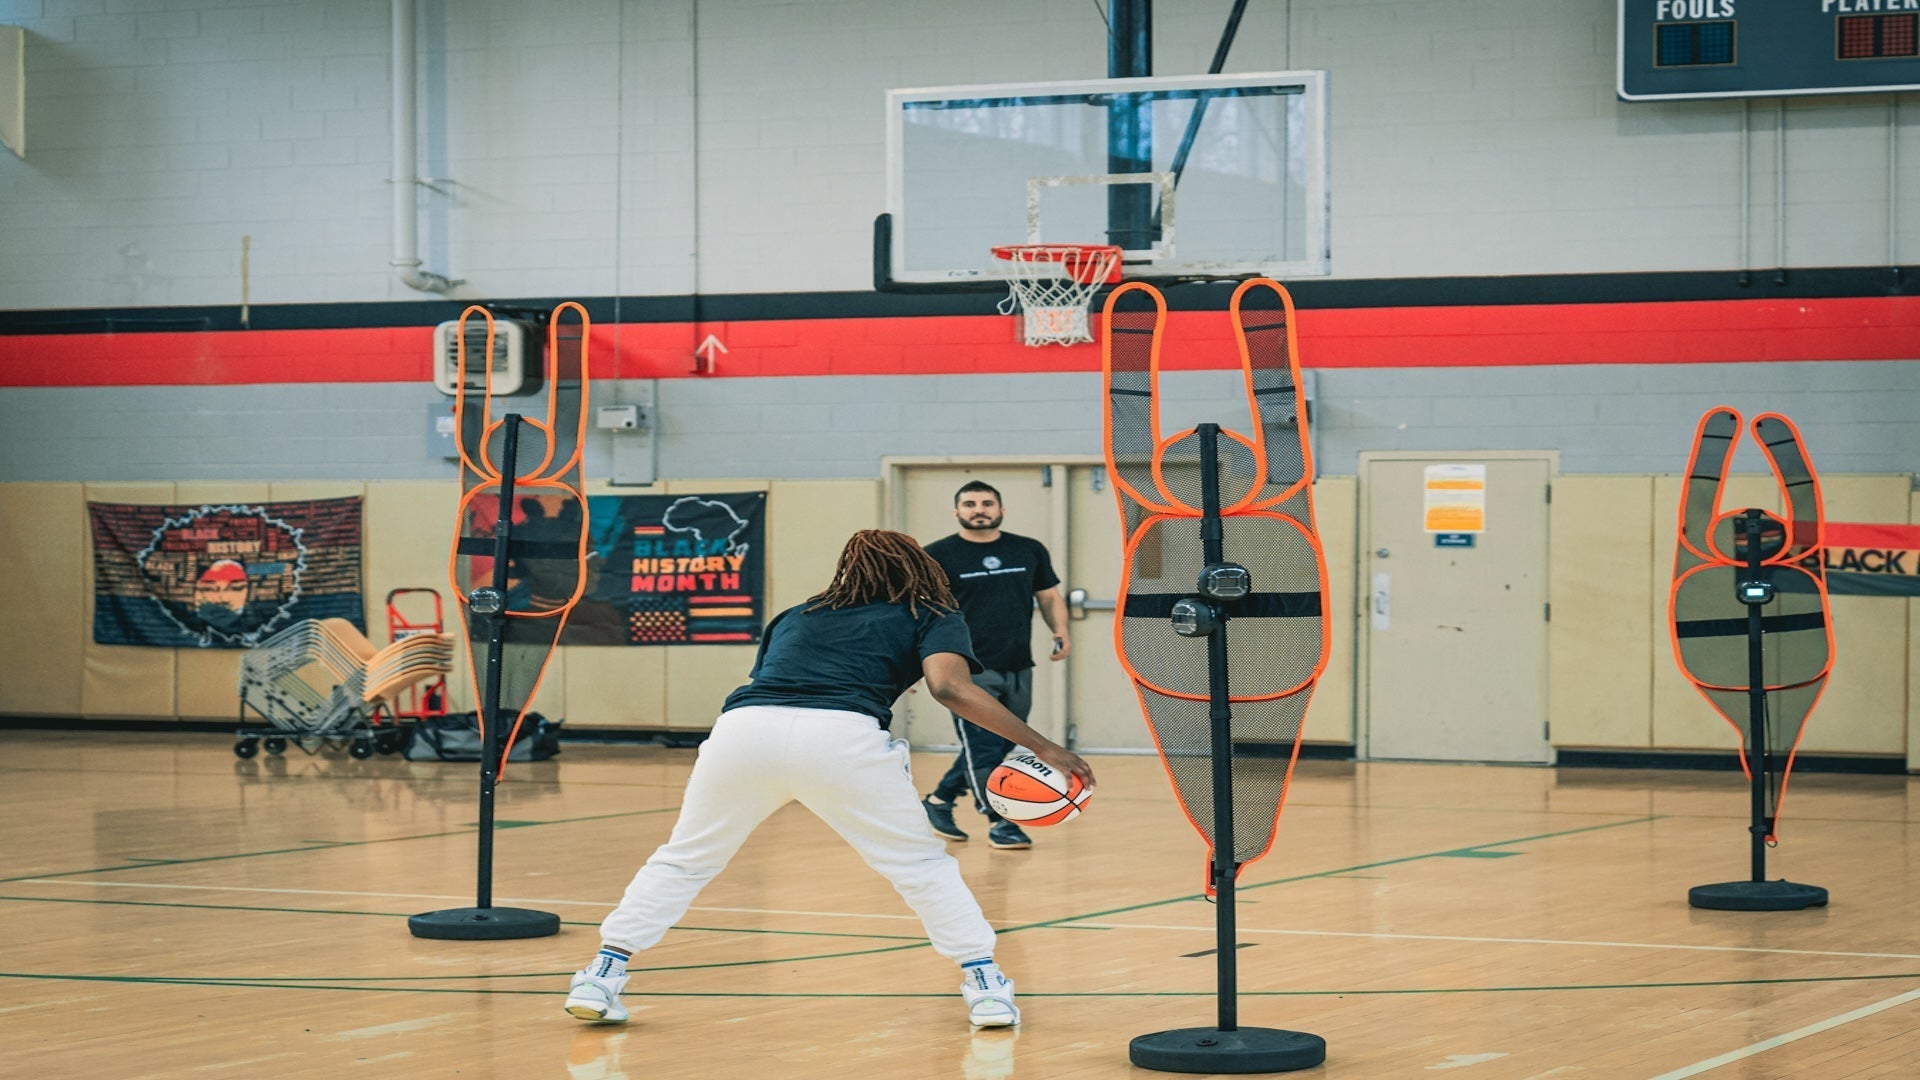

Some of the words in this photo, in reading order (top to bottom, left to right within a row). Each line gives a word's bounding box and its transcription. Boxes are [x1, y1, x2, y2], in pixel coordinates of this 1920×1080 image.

[1656, 0, 1736, 20] FOULS
[633, 538, 728, 557] BLACK
[632, 555, 745, 574] HISTORY
[631, 572, 740, 592] MONTH
